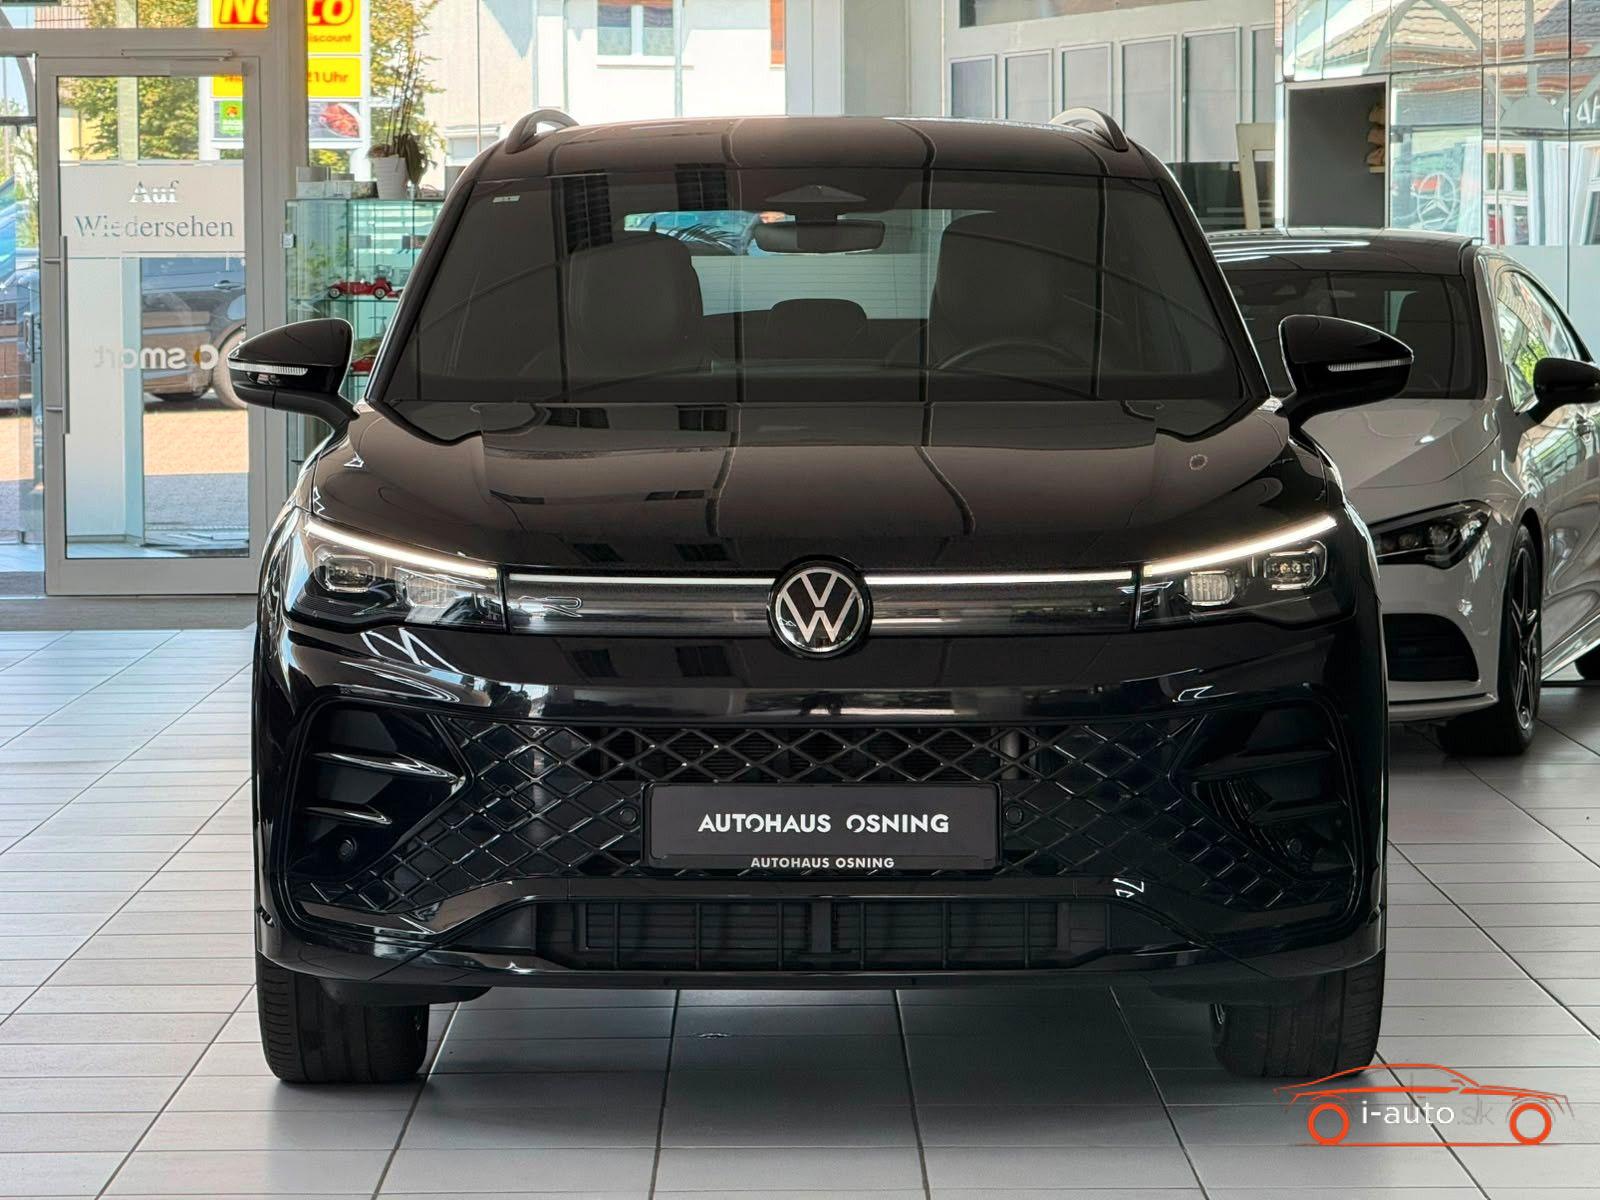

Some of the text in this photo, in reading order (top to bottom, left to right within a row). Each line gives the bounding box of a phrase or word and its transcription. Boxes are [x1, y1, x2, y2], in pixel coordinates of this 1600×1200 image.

[307, 33, 352, 42] iscount
[322, 71, 349, 83] Uhr
[128, 180, 179, 203] Auf
[74, 215, 234, 237] Wiedersehen
[697, 813, 949, 833] AUTOHAUS OSNING
[750, 857, 895, 869] AUTOHAUS OSNING
